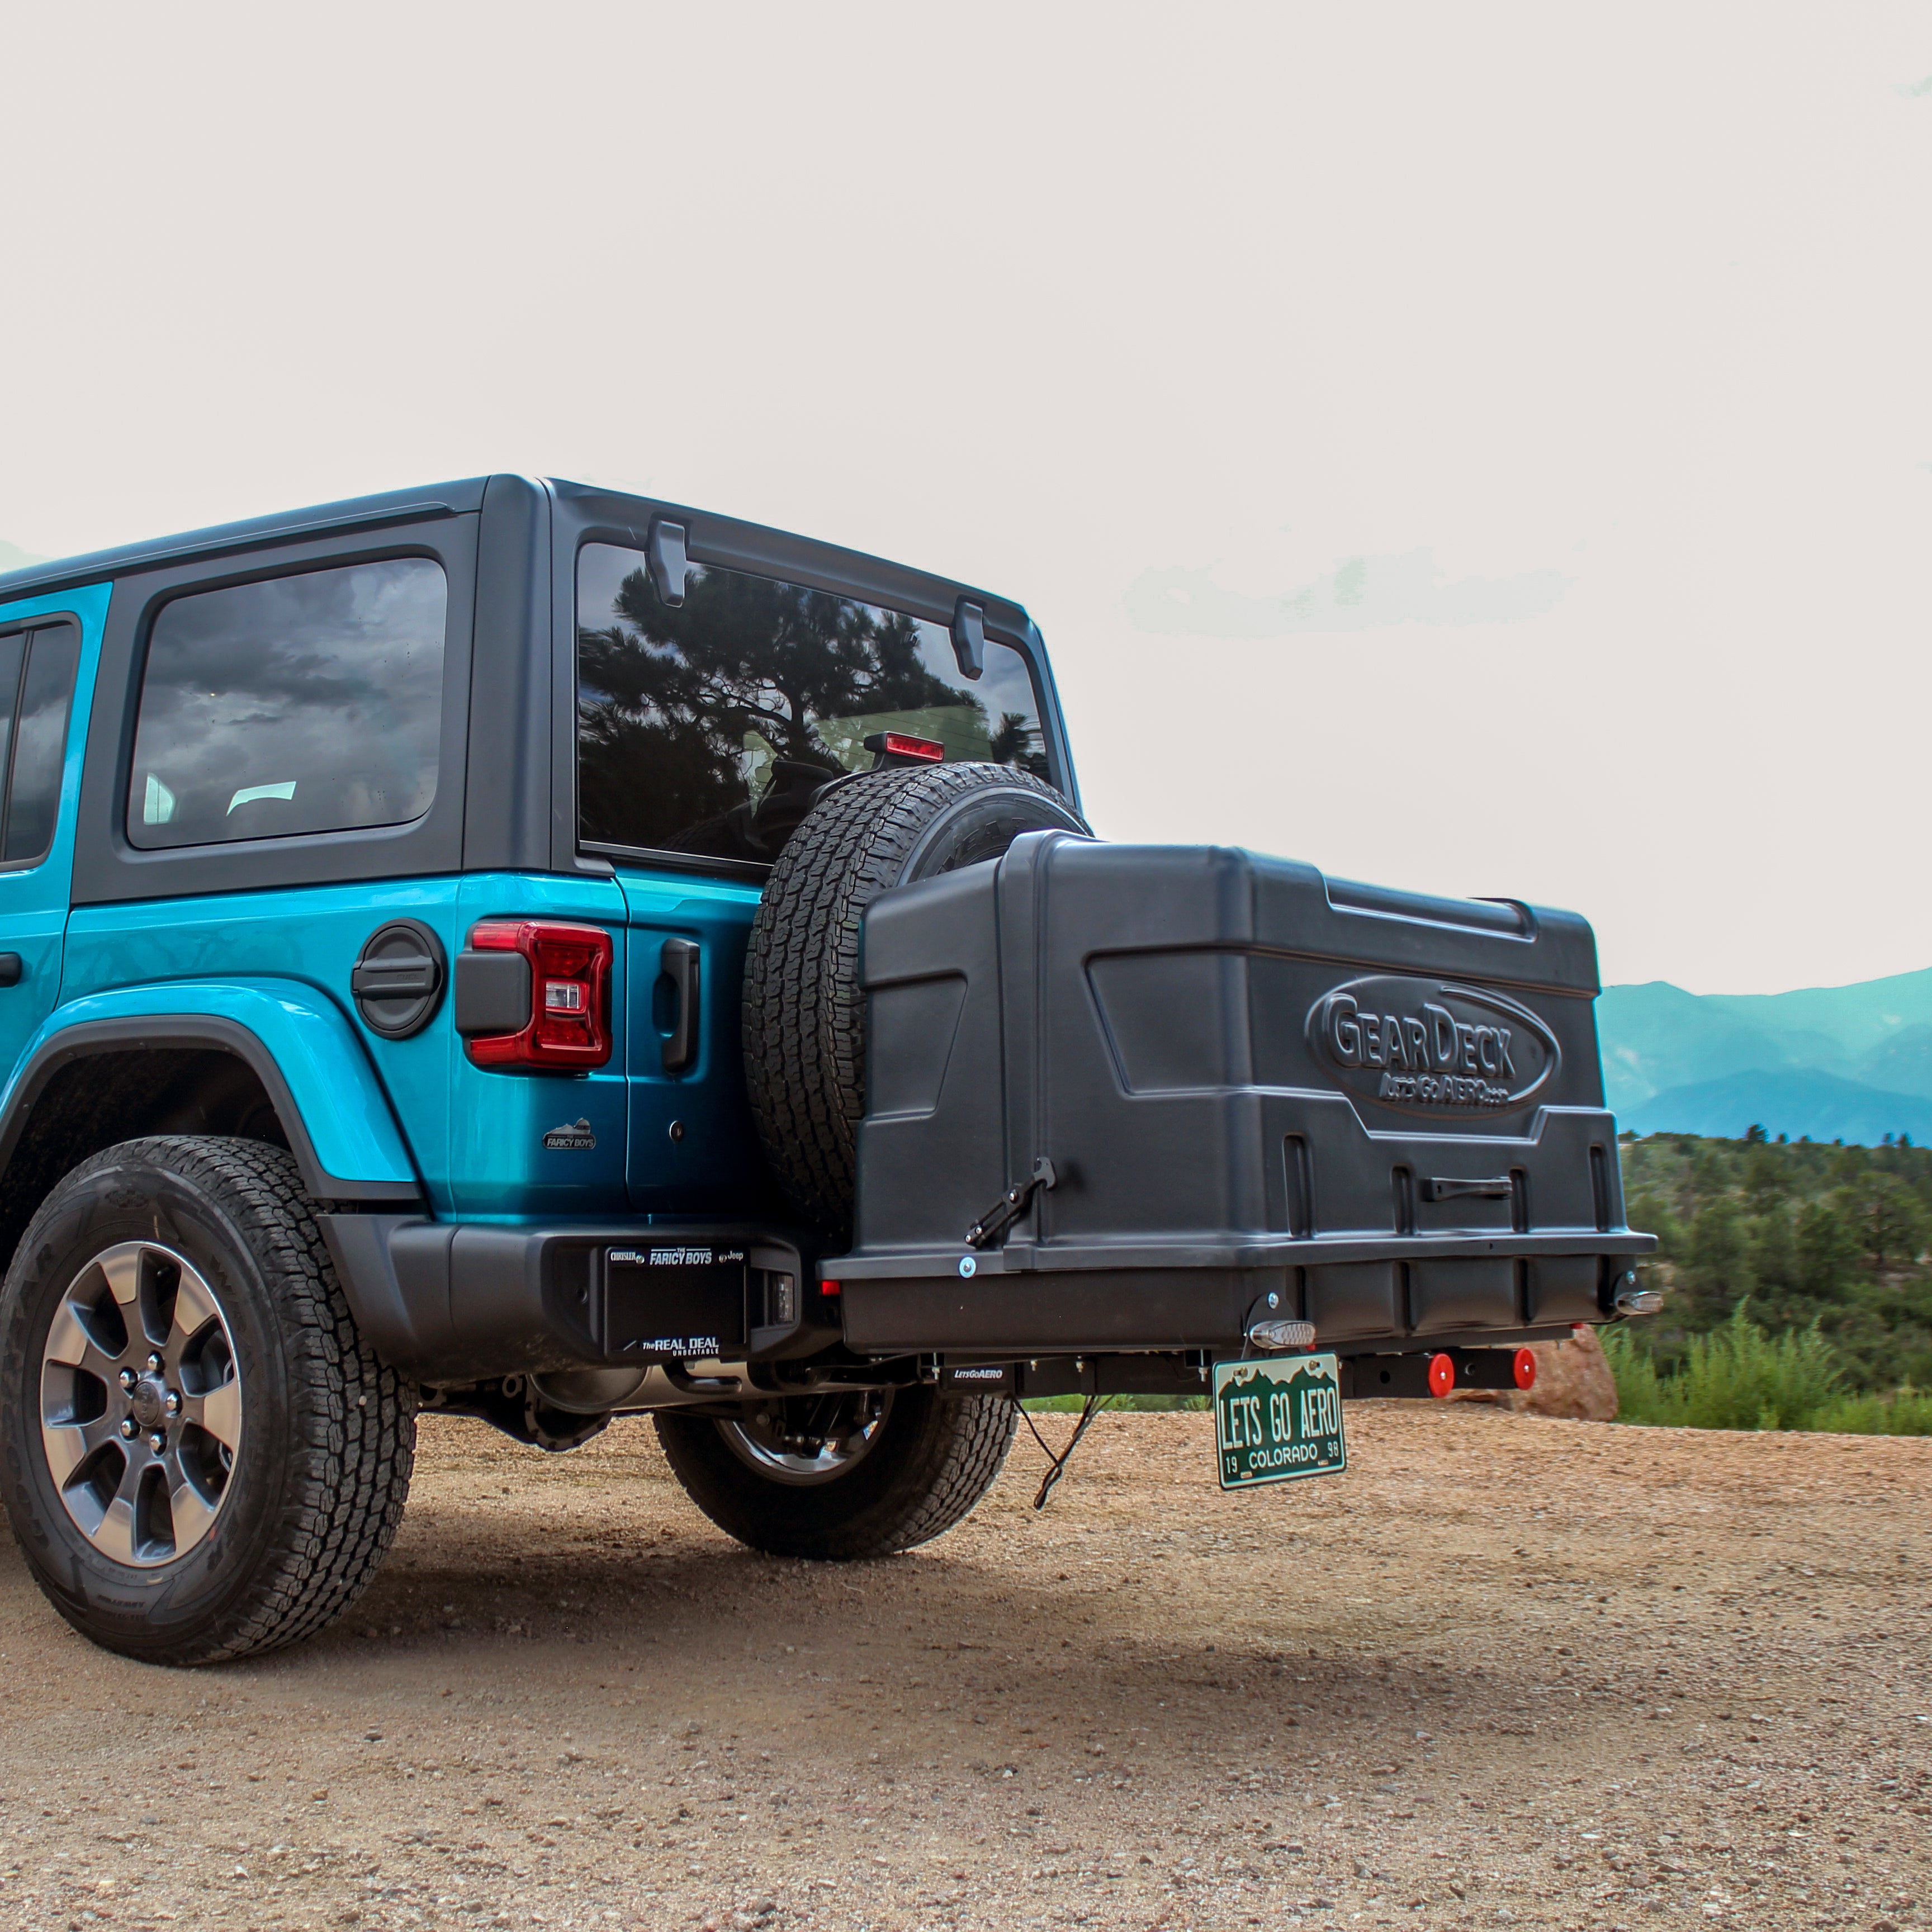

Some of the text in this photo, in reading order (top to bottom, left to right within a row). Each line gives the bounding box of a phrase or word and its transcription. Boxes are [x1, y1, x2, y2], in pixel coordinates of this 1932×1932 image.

[1323, 993, 1516, 1078] GEARDECK
[547, 1138, 574, 1147] FARICY
[611, 1252, 636, 1261] CHRYSLER
[650, 1252, 712, 1265] FARICY BOYS
[728, 1251, 744, 1261] Jeep
[655, 1339, 686, 1351] REAL
[689, 1337, 719, 1348] DEAL
[673, 1348, 719, 1357] UNBEATABLE
[1220, 1387, 1338, 1450] LETS GO AERO
[1226, 1441, 1339, 1474] 19 COLORADO 98
